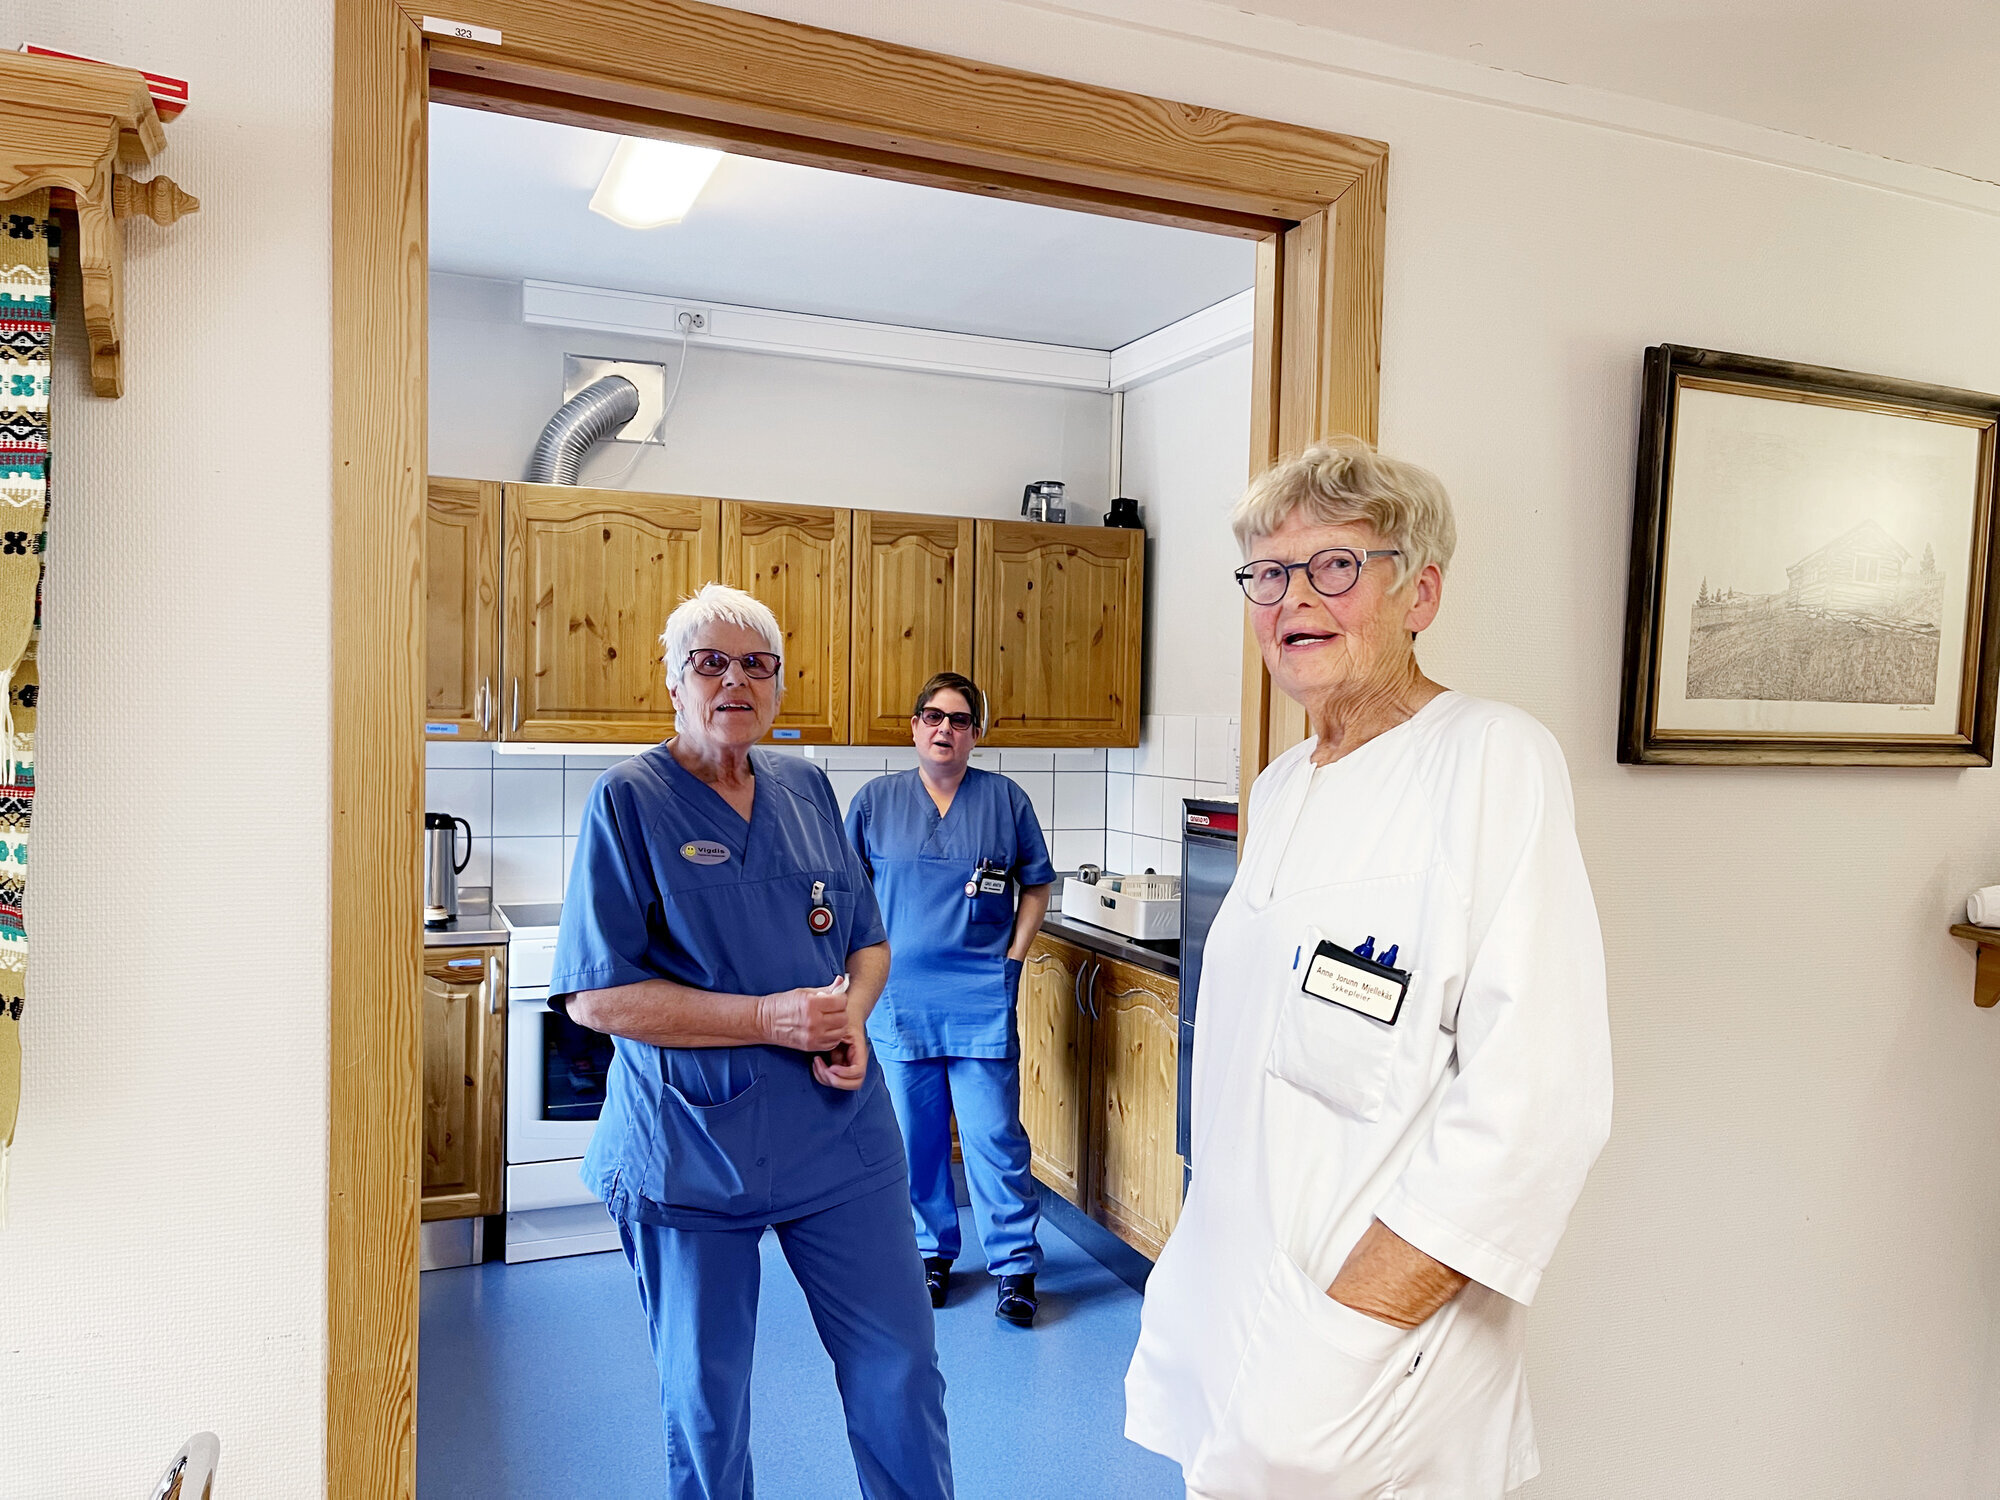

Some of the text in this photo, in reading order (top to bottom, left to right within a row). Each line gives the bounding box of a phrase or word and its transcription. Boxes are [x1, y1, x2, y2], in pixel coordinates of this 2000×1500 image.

[455, 28, 472, 38] 323
[1316, 966, 1334, 978] Anne
[1336, 974, 1359, 988] Jorunn
[1331, 982, 1371, 1002] Sykepleier
